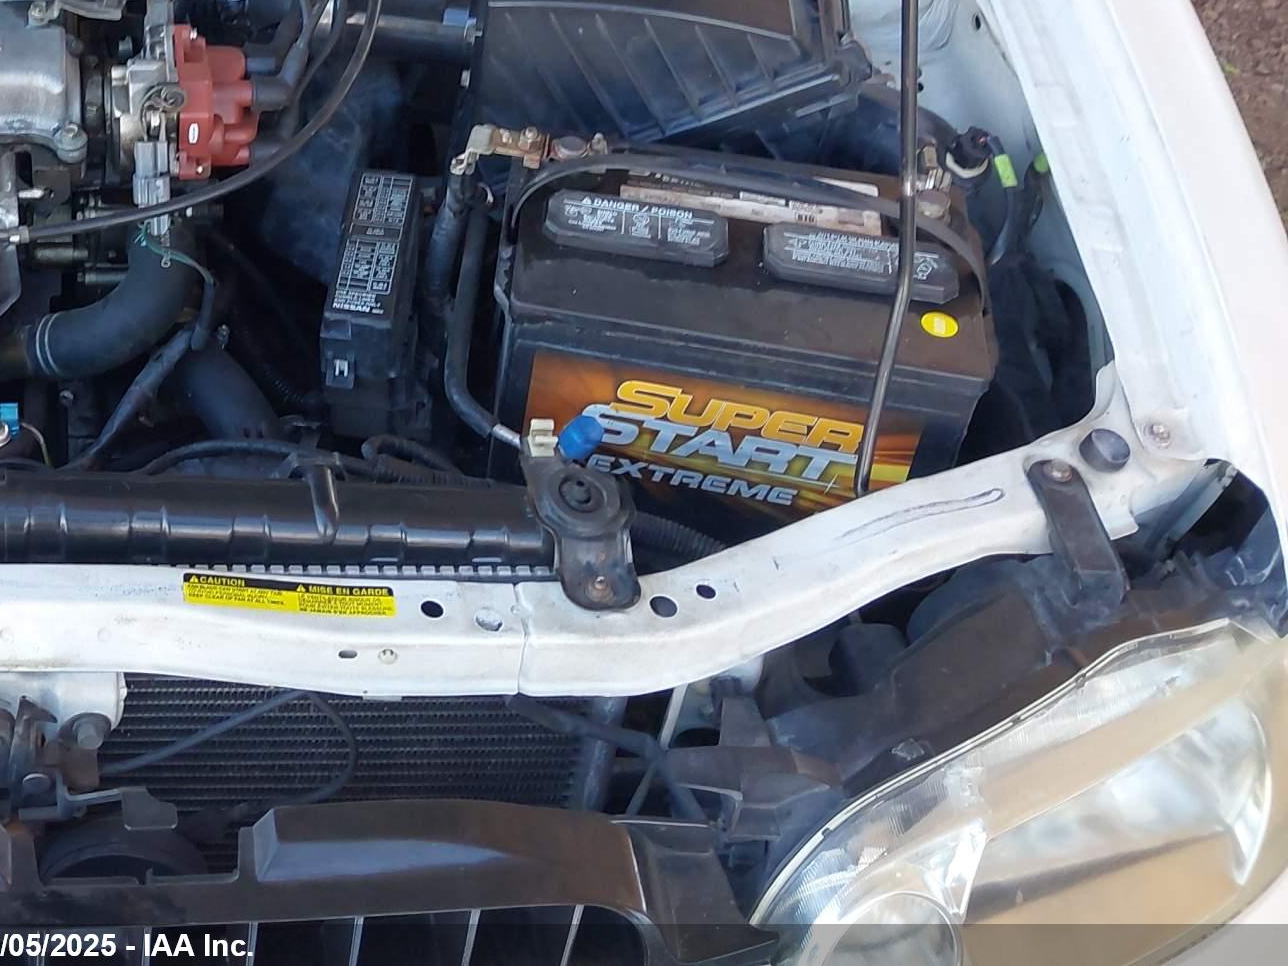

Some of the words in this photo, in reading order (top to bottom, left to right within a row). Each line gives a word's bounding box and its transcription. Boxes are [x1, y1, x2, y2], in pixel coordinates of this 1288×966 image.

[594, 197, 640, 211] DANGER
[651, 204, 693, 219] POISON
[332, 302, 371, 313] NISSAN
[608, 380, 864, 454] SUPER
[580, 404, 860, 481] START
[586, 454, 798, 506] EXTREME
[199, 576, 245, 587] CAUTION
[308, 585, 332, 595] MISE
[336, 586, 350, 595] EN
[352, 587, 389, 596] GARDE
